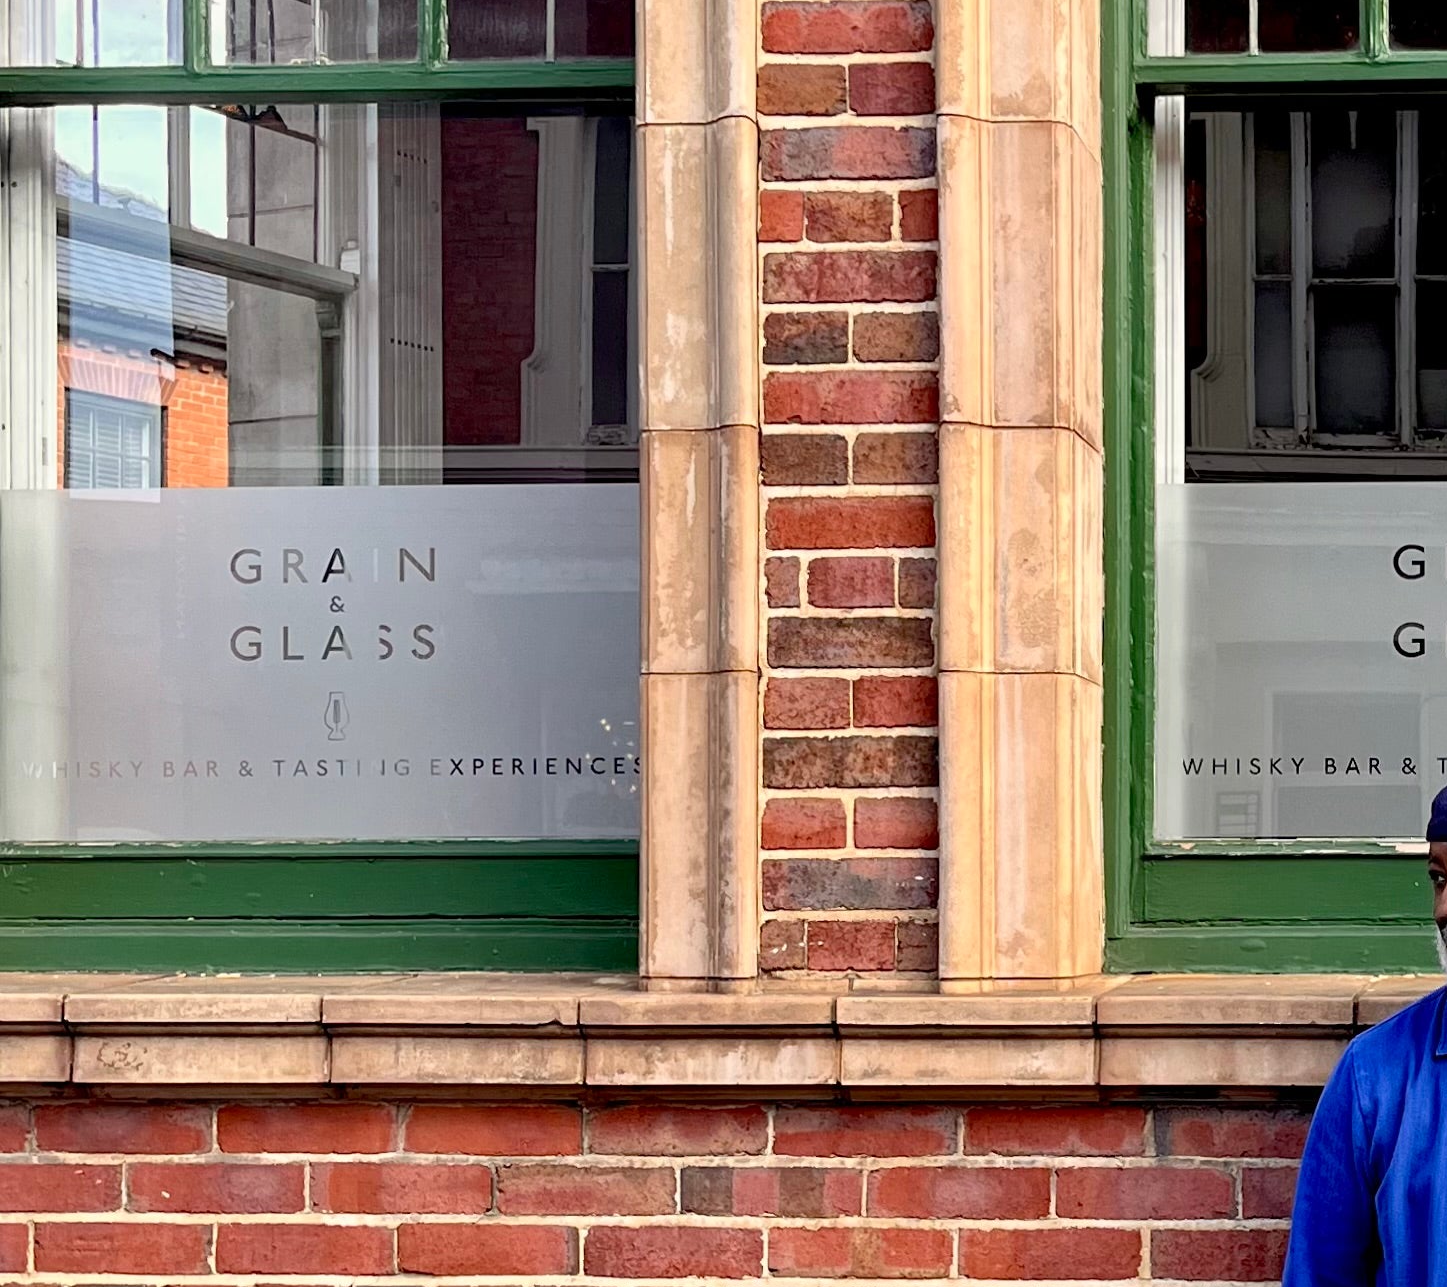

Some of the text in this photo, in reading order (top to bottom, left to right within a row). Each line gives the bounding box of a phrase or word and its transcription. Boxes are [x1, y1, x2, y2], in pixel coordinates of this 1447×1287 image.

[230, 547, 436, 584] GRAIN
[329, 595, 345, 613] &
[230, 624, 436, 661] GLASS
[164, 761, 219, 778] BAR
[239, 760, 254, 778] &
[1183, 757, 1305, 775] WHISKY
[1325, 757, 1382, 775] BAR
[1402, 756, 1417, 775] &
